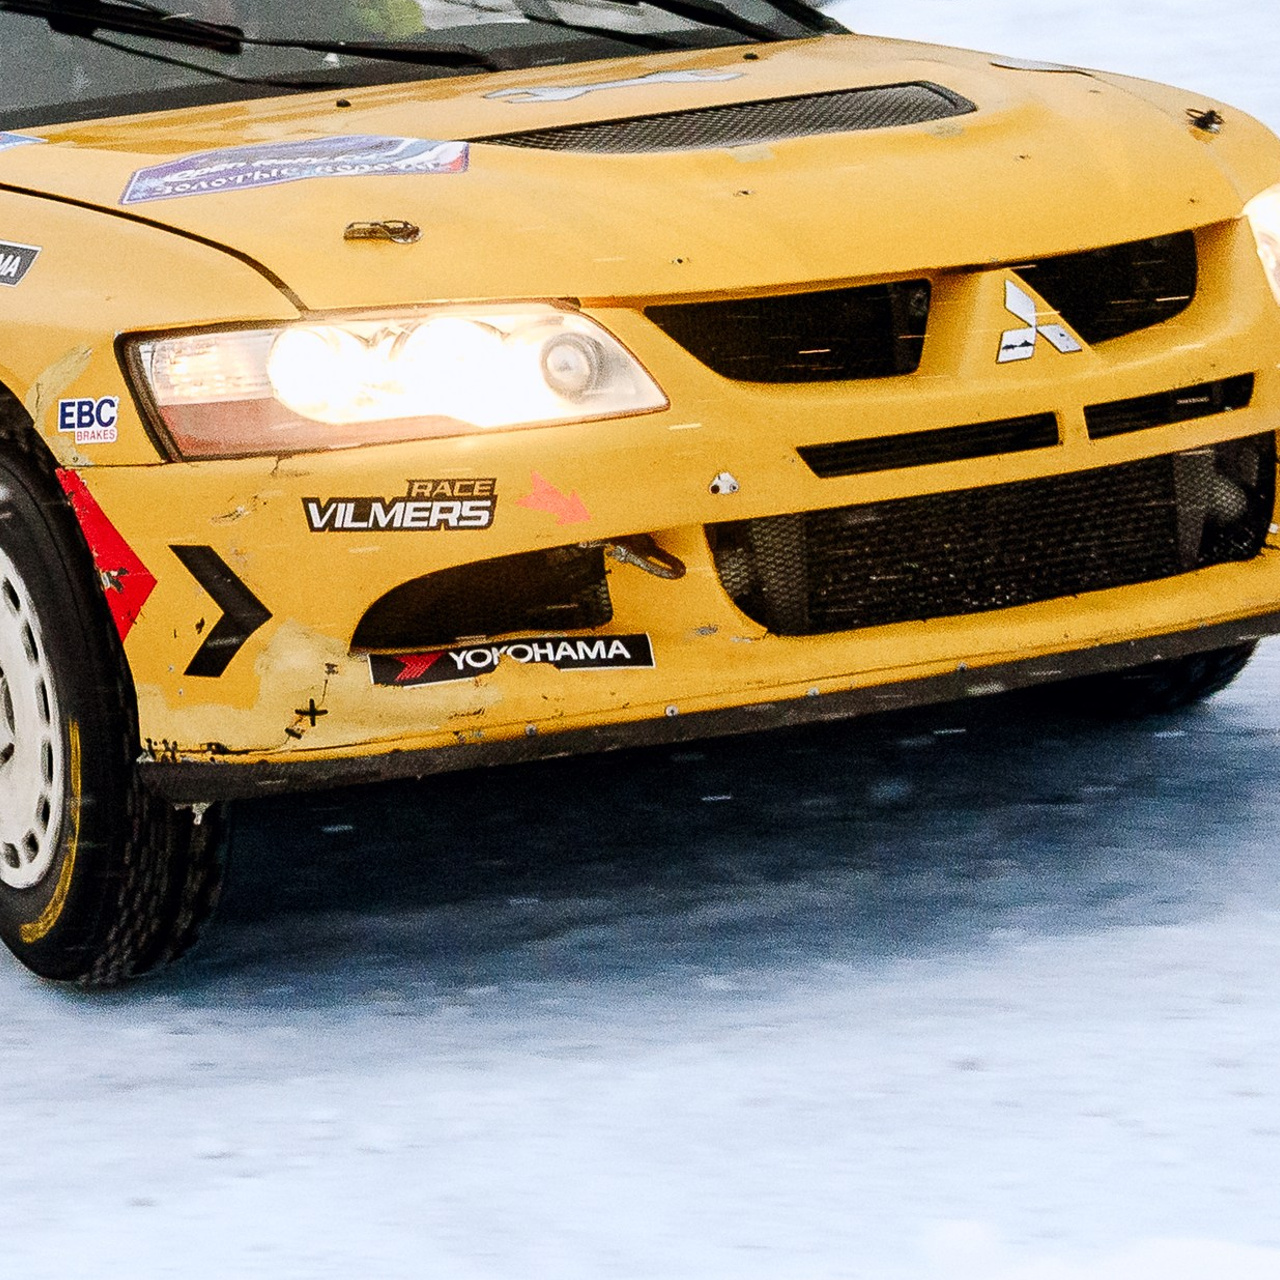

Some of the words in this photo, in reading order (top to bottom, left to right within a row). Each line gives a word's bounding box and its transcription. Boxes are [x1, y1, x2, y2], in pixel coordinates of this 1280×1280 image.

[60, 398, 115, 429] EBC
[76, 429, 115, 441] BRAKES
[410, 480, 493, 497] RACE
[308, 500, 492, 528] VILMERS
[448, 639, 631, 670] YOKOHAMA
